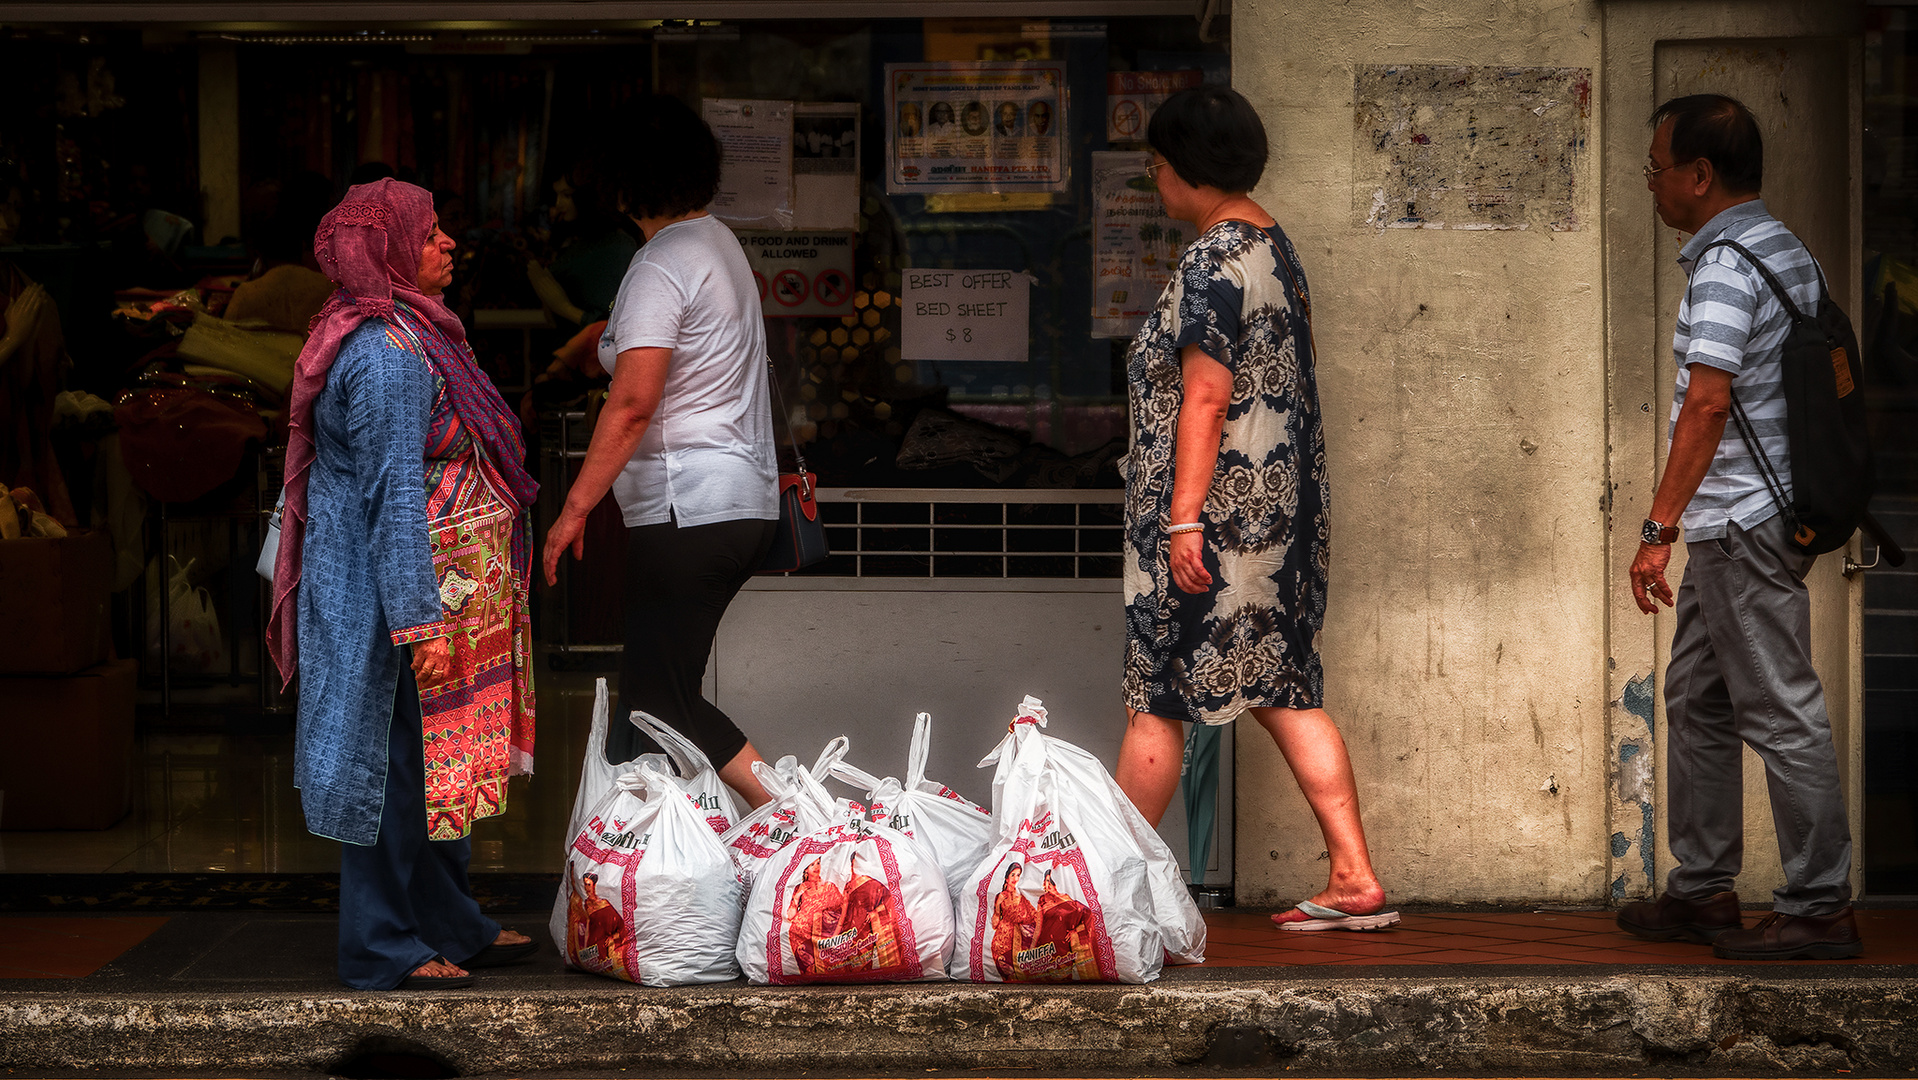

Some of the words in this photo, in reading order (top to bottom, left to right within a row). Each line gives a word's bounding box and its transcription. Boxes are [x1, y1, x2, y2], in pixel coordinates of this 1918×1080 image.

[751, 237, 782, 246] FOOD
[786, 237, 809, 246] AND
[813, 236, 848, 246] DRINK
[761, 249, 817, 258] ALLOWED
[910, 273, 954, 289] BEST
[962, 272, 1012, 289] OFFER
[916, 302, 951, 316] BED
[957, 302, 1008, 317] SHEET
[818, 927, 858, 949] HANIFFA
[857, 933, 879, 949] Center
[1017, 942, 1055, 963] HANIFFA
[1056, 951, 1078, 965] Center
